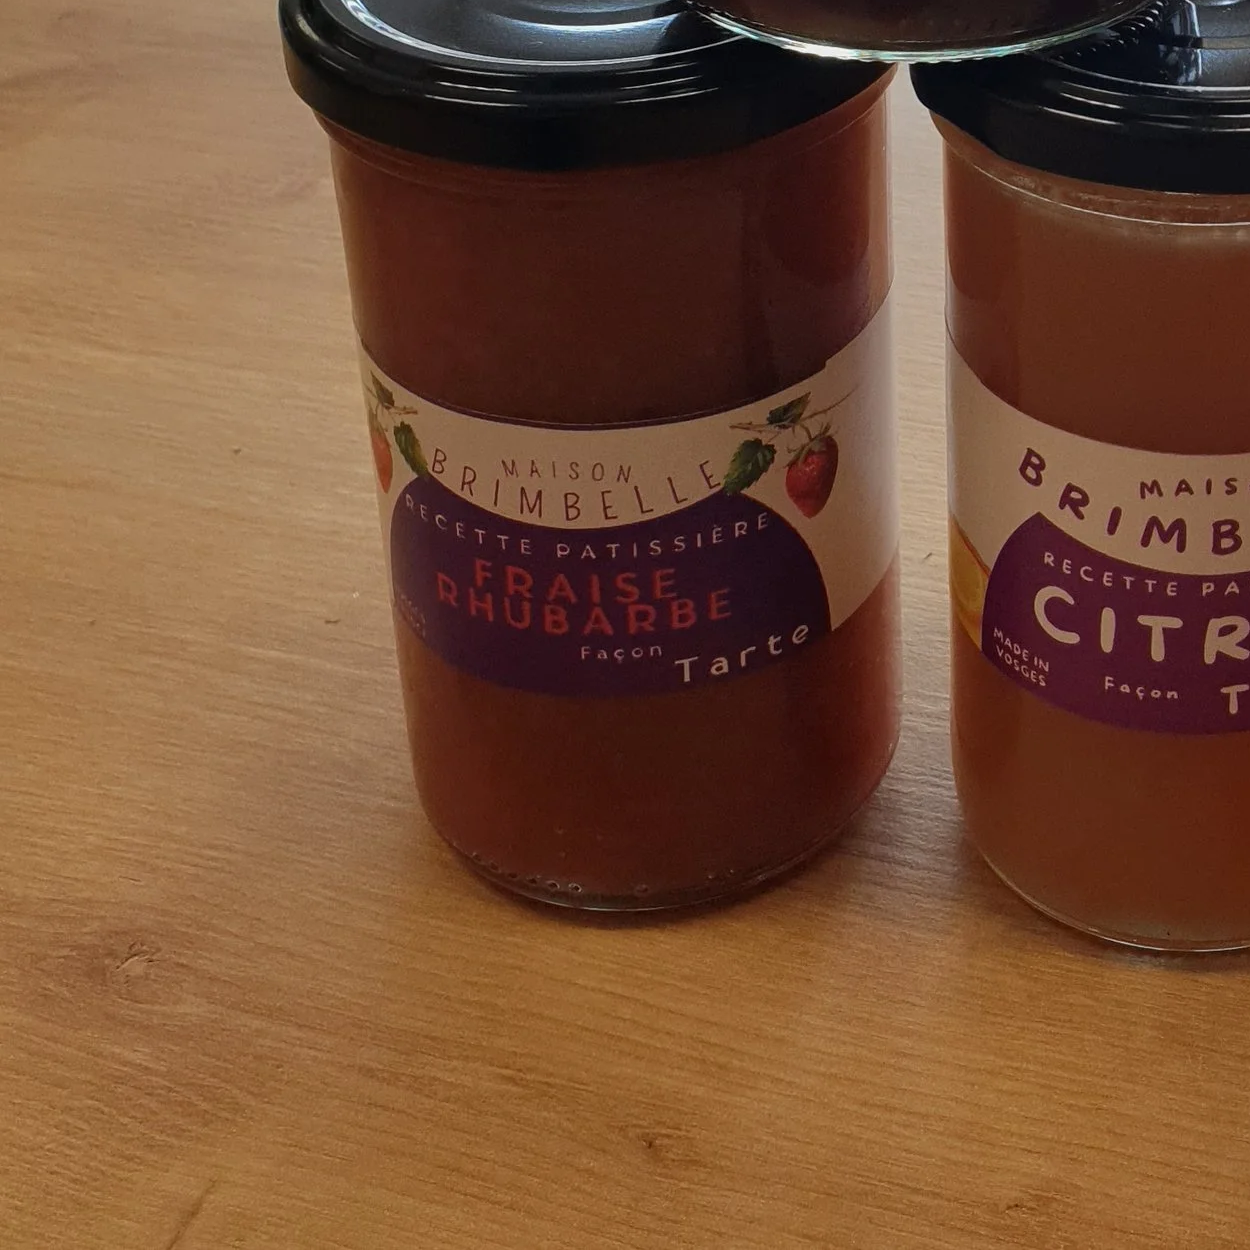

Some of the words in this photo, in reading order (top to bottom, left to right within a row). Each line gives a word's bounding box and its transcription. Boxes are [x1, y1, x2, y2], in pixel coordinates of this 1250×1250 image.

[431, 449, 721, 521] BRIMBELLE
[503, 460, 632, 483] MAISON
[405, 494, 531, 555] RECETTE
[557, 513, 769, 558] PATISSIÈRE
[475, 559, 677, 604] FRAISE
[1044, 552, 1178, 596] RECETTE
[437, 572, 732, 636] RHUBARBE
[581, 645, 662, 662] Façon
[675, 624, 809, 683] Tarte
[994, 627, 1030, 662] MADE
[1033, 655, 1050, 672] IN
[996, 645, 1047, 686] VOSGES
[1104, 677, 1178, 701] Façon
